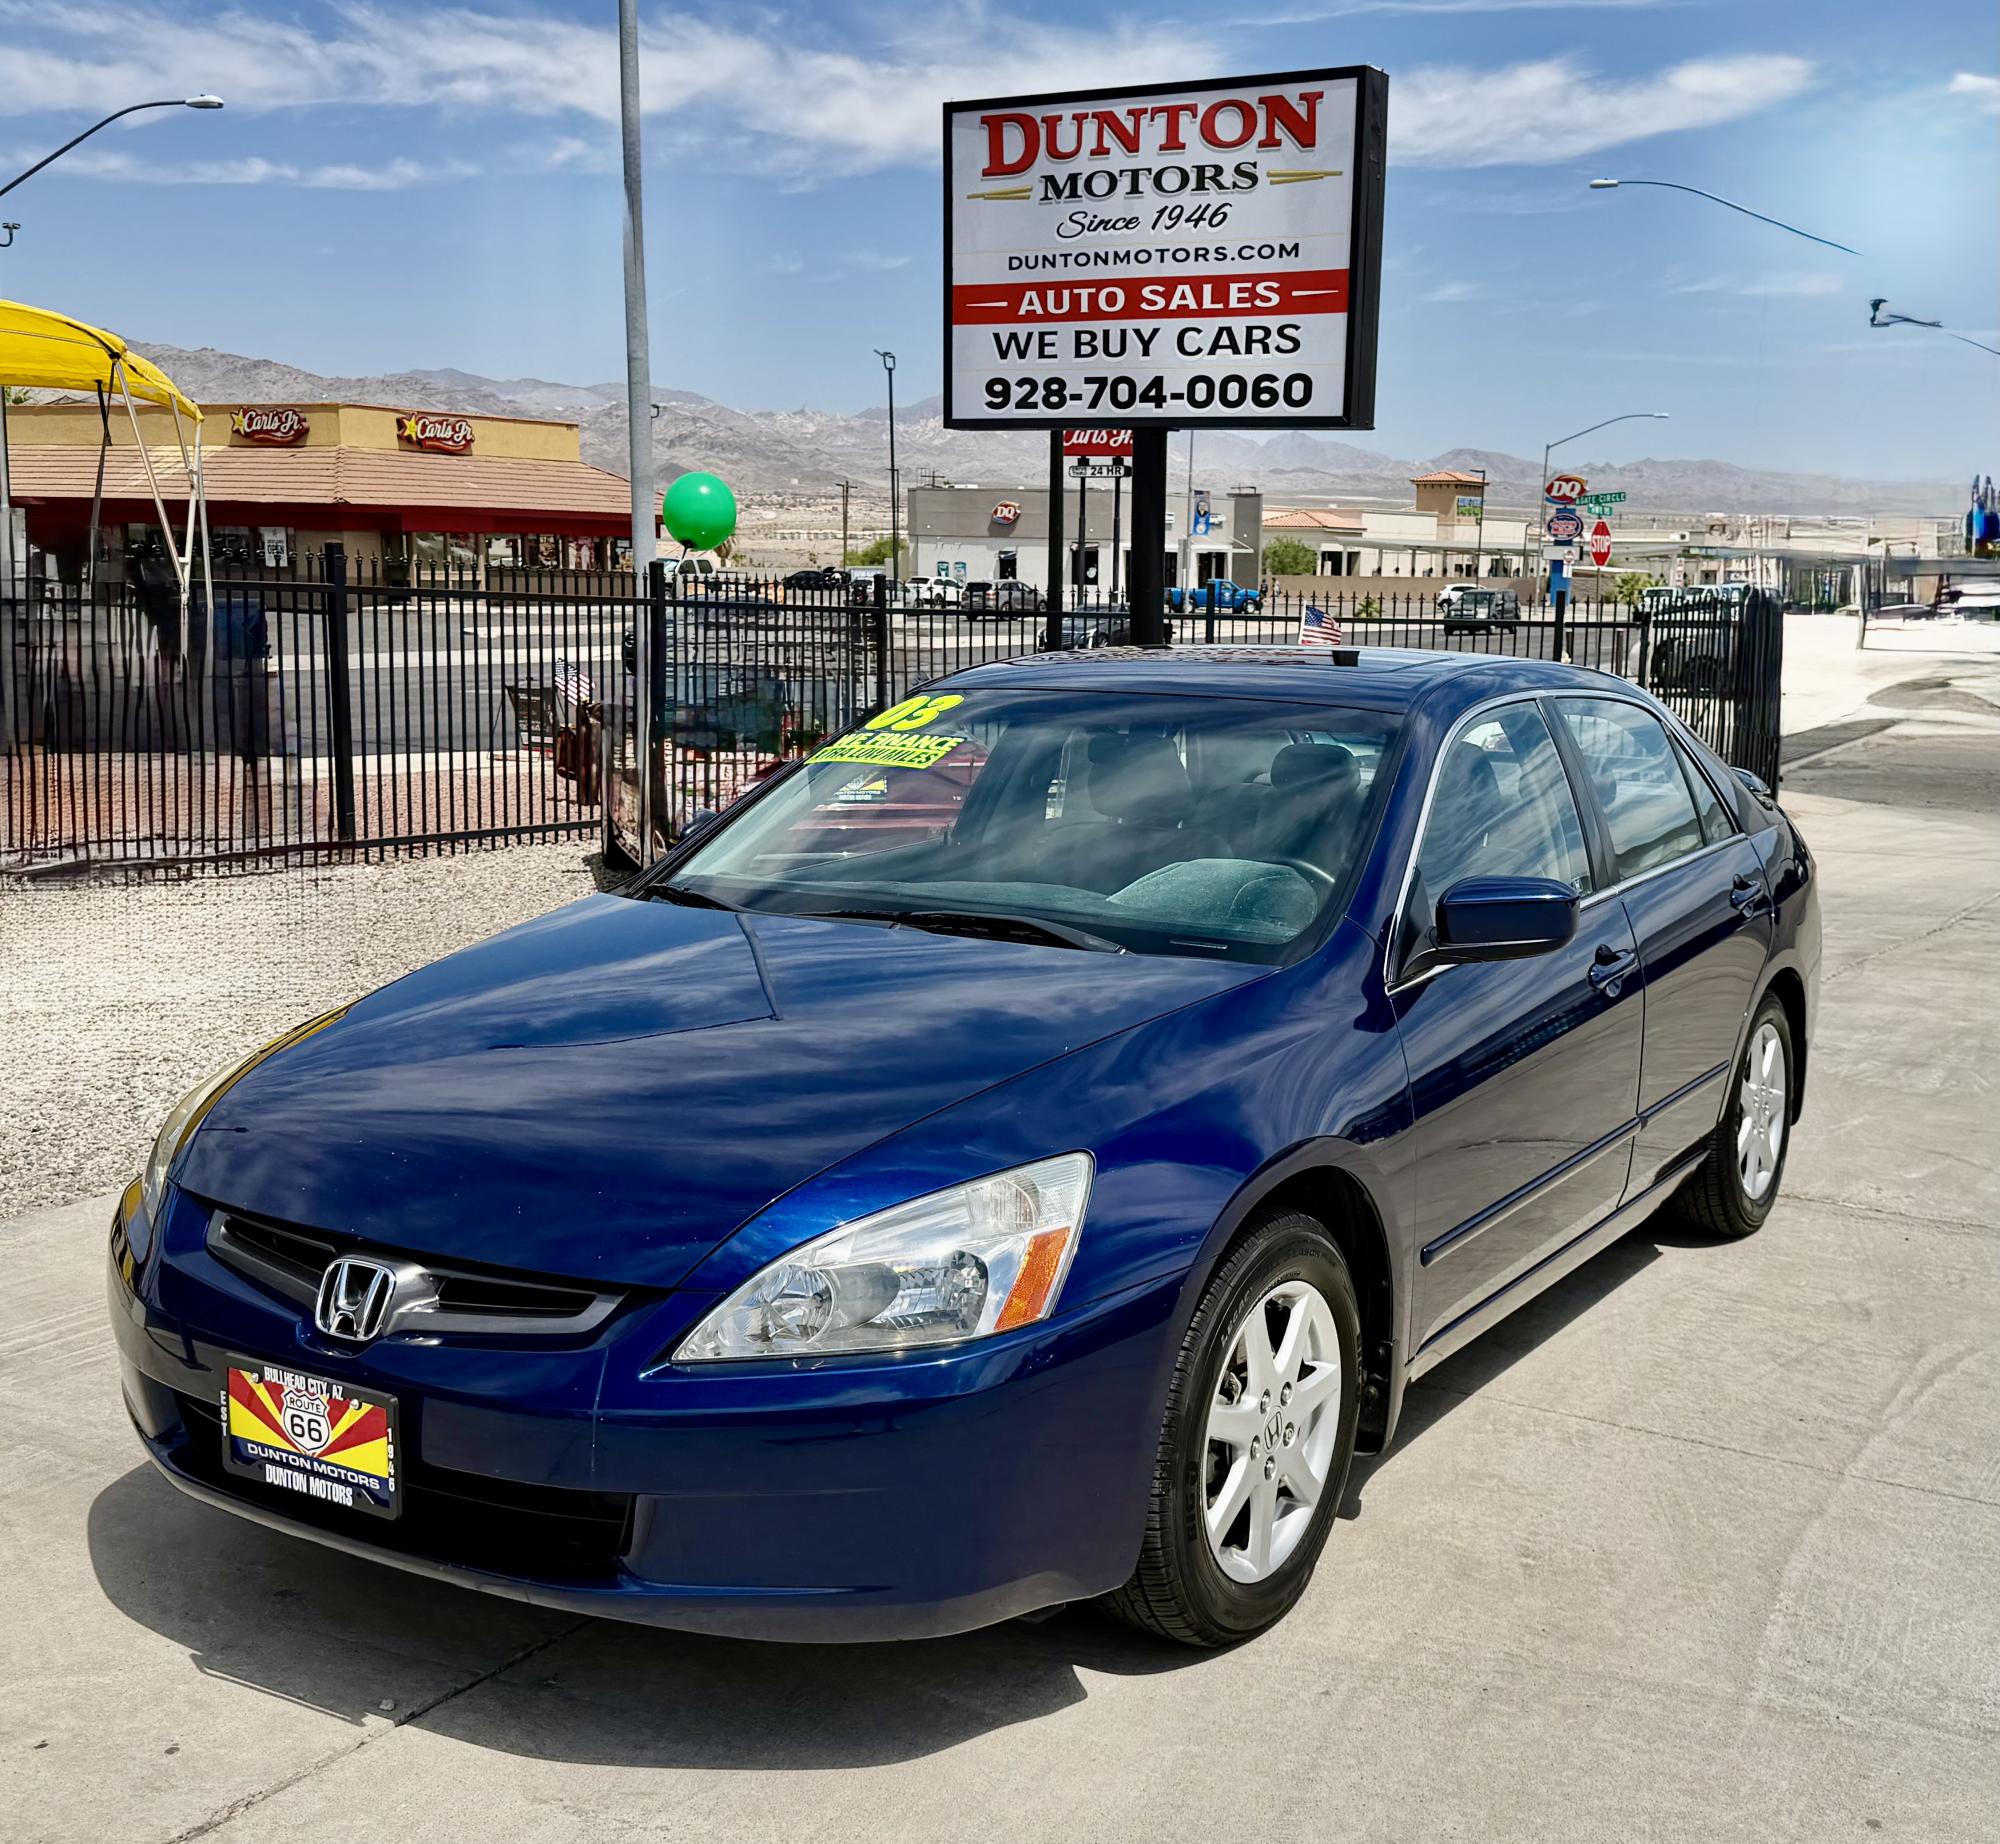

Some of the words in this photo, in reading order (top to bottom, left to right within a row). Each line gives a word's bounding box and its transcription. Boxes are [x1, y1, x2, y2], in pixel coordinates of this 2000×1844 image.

[981, 91, 1324, 178] DUNTON
[1040, 161, 1259, 201] MOTORS
[1056, 210, 1140, 238] Since
[1151, 202, 1233, 231] 1946
[1008, 242, 1300, 271] DUNTONMOTORS.COM
[1018, 286, 1126, 316] AUTO
[1140, 281, 1281, 311] SALES
[992, 331, 1059, 360] WE
[1073, 327, 1161, 359] BUY
[1176, 323, 1302, 357] CARS
[984, 372, 1313, 409] 928-704-0060
[244, 410, 281, 432] Carl's
[1090, 466, 1103, 476] 24
[1106, 466, 1122, 476] HR
[1550, 481, 1581, 499] DQ
[1599, 492, 1625, 503] CIRCLE
[996, 506, 1016, 519] DQ
[1591, 534, 1612, 553] STOP
[864, 694, 965, 731] 03
[833, 732, 875, 747] WE
[871, 733, 965, 752] FINANCE
[879, 748, 940, 764] MILES
[264, 1366, 306, 1391] BULLHEAD
[308, 1378, 329, 1399] CITY,
[332, 1385, 344, 1401] AZ
[289, 1396, 322, 1413] ROUTE
[290, 1413, 323, 1443] 66
[247, 1442, 312, 1470] DUNTON
[313, 1460, 381, 1490] MOTORS
[265, 1463, 307, 1494] DUNTON
[309, 1477, 353, 1507] MOTORS
